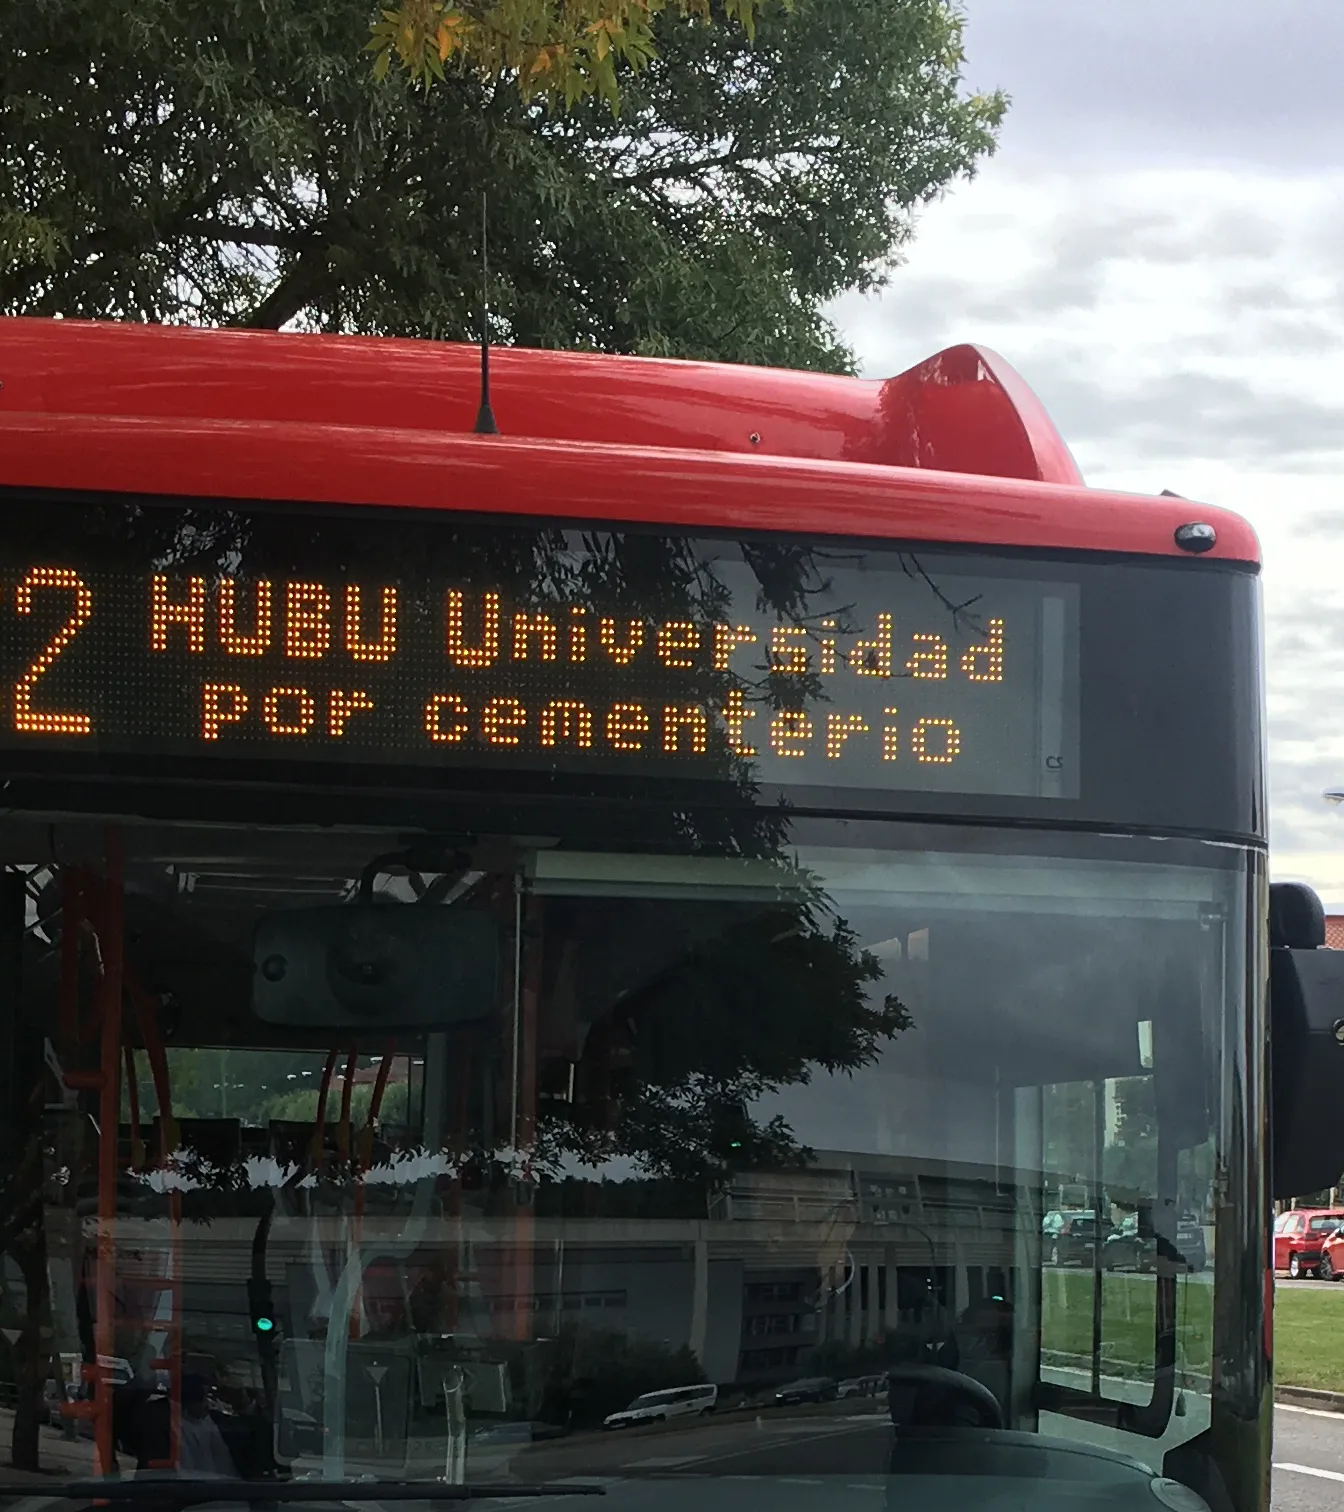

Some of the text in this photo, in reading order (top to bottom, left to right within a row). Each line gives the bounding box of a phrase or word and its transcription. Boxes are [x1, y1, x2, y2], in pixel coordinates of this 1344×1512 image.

[151, 575, 1004, 682] HUBU Universidad
[202, 683, 961, 763] por cementerio
